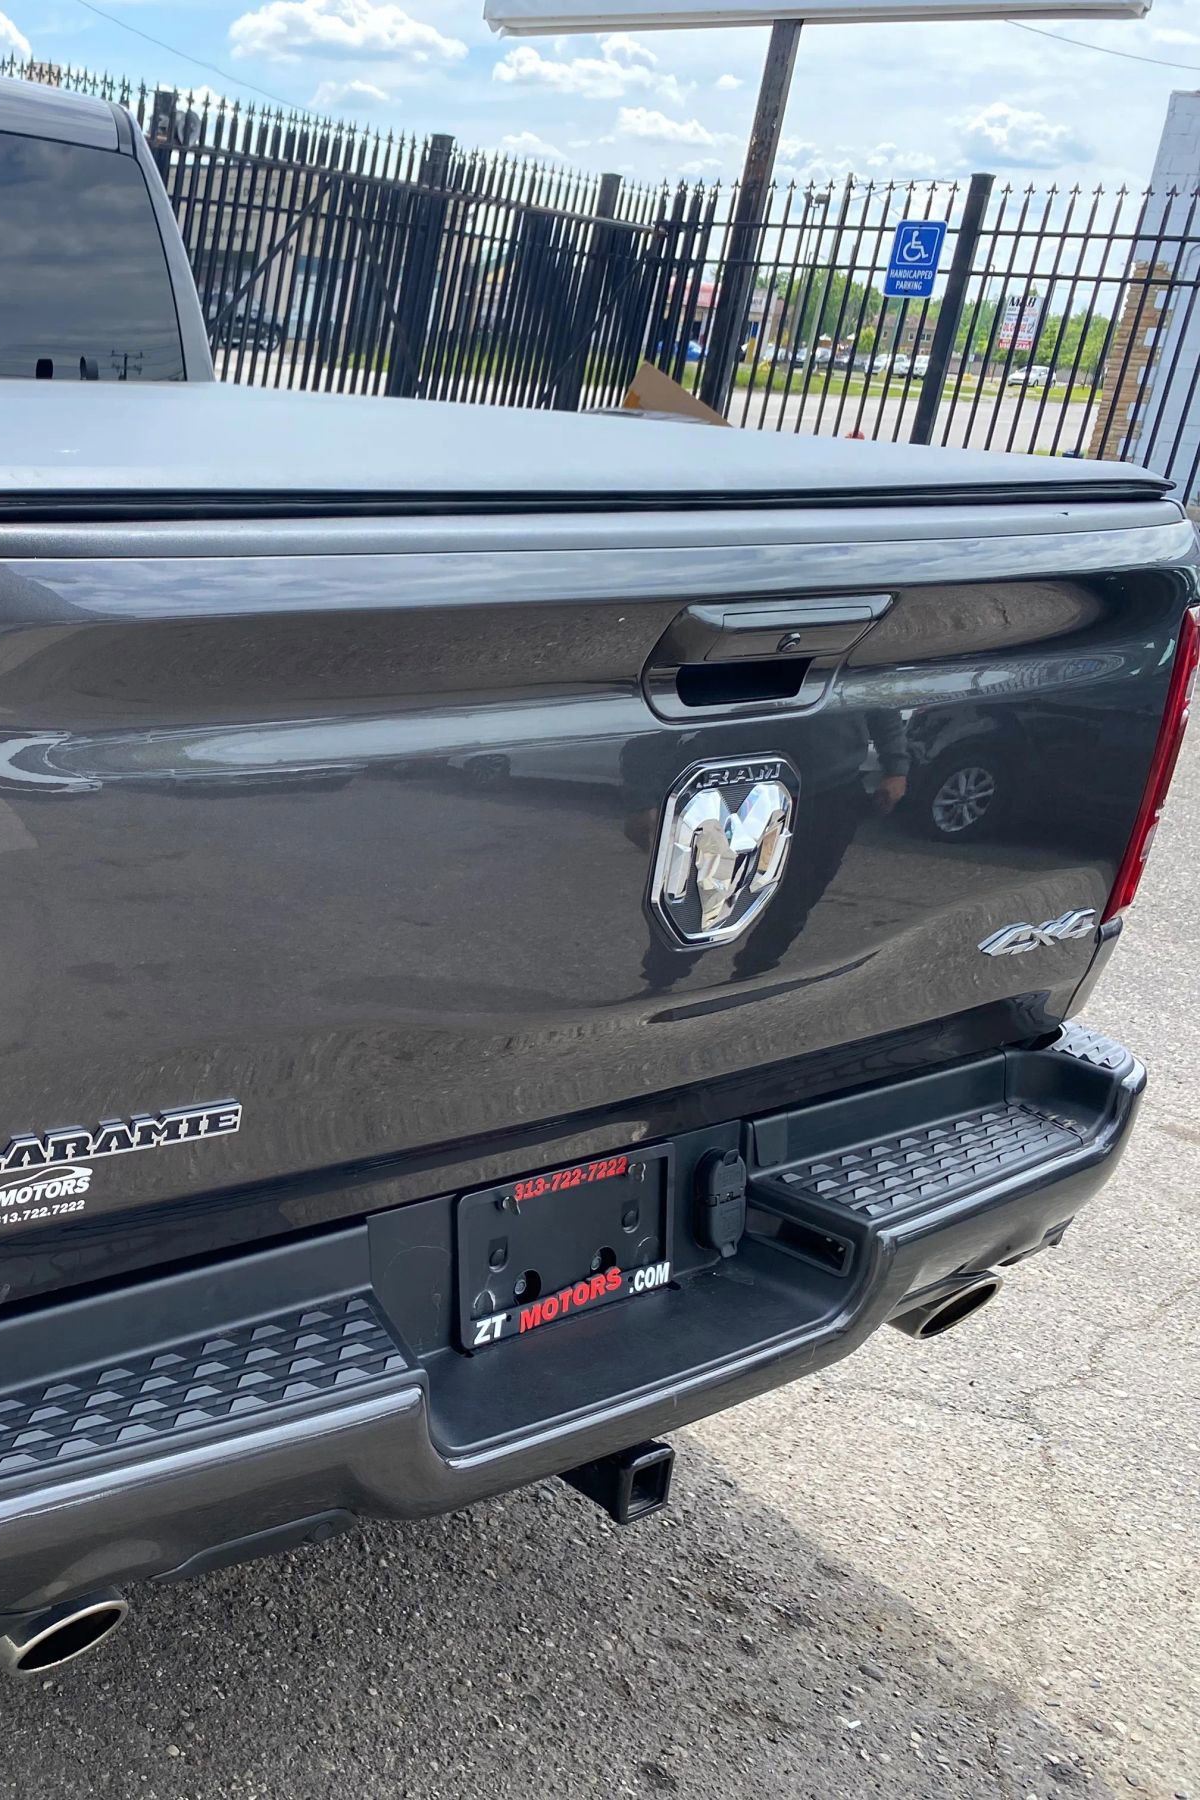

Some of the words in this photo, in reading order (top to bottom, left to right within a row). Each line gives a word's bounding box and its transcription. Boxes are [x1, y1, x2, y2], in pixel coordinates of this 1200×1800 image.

[889, 268, 933, 280] HANDICAPPED
[895, 280, 923, 291] PARKING
[699, 763, 781, 788] RAM
[514, 1156, 628, 1202] 313-722-7222
[473, 1313, 507, 1345] ZT
[519, 1266, 623, 1334] MOTORS
[628, 1261, 671, 1294] .COM
